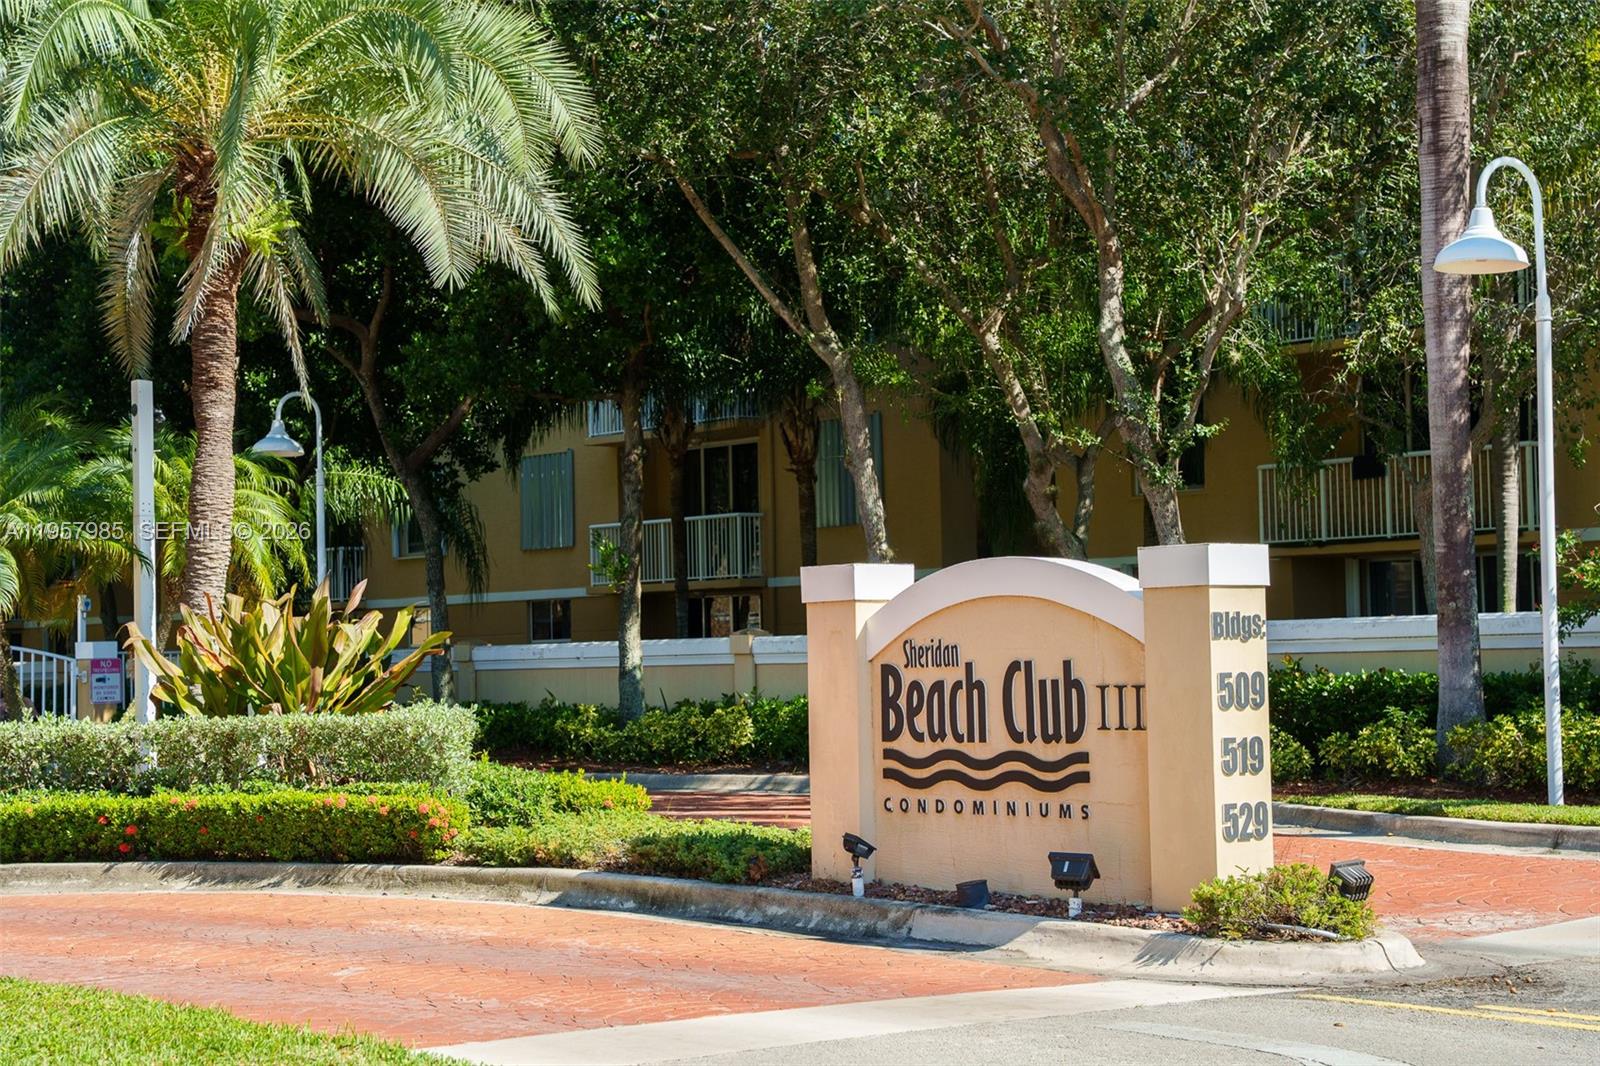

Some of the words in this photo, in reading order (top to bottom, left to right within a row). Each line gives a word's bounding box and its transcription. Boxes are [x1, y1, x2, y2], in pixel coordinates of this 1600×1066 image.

[1211, 611, 1266, 643] Bldgs:
[100, 660, 112, 668] NO
[903, 639, 960, 669] Sheridan
[881, 662, 988, 743] Beach
[1002, 660, 1087, 744] Club
[1096, 685, 1146, 730] III
[1217, 671, 1265, 711] 509
[1221, 736, 1264, 777] 519
[884, 797, 1090, 820] CONDOMINIUMS
[1222, 801, 1268, 843] 529
